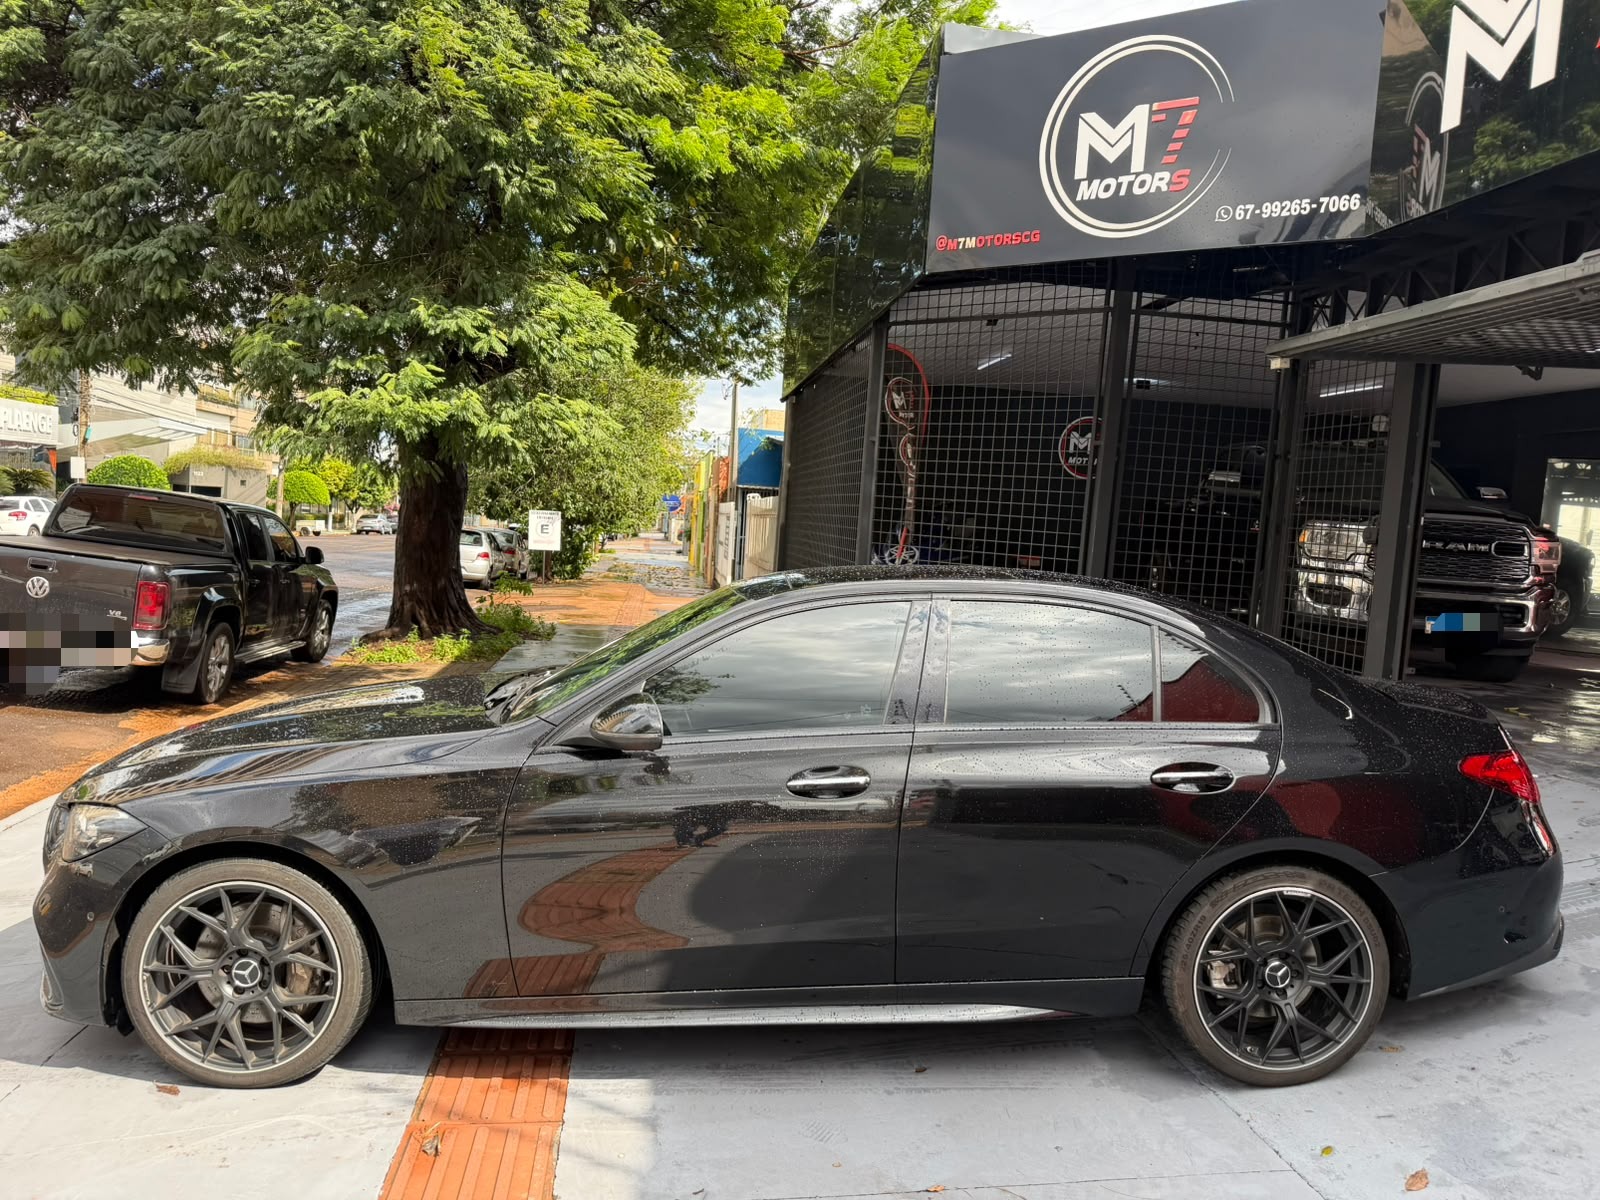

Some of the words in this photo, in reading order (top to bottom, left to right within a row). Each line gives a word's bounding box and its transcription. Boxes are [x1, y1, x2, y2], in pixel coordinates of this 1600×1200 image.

[1440, 0, 1600, 134] M
[1074, 96, 1200, 180] M7
[1075, 168, 1192, 202] MOTORS
[1235, 193, 1361, 220] 67-99265-7066
[935, 229, 1041, 252] @M7MOTORSCG
[540, 523, 550, 534] E
[1422, 540, 1489, 552] RAM
